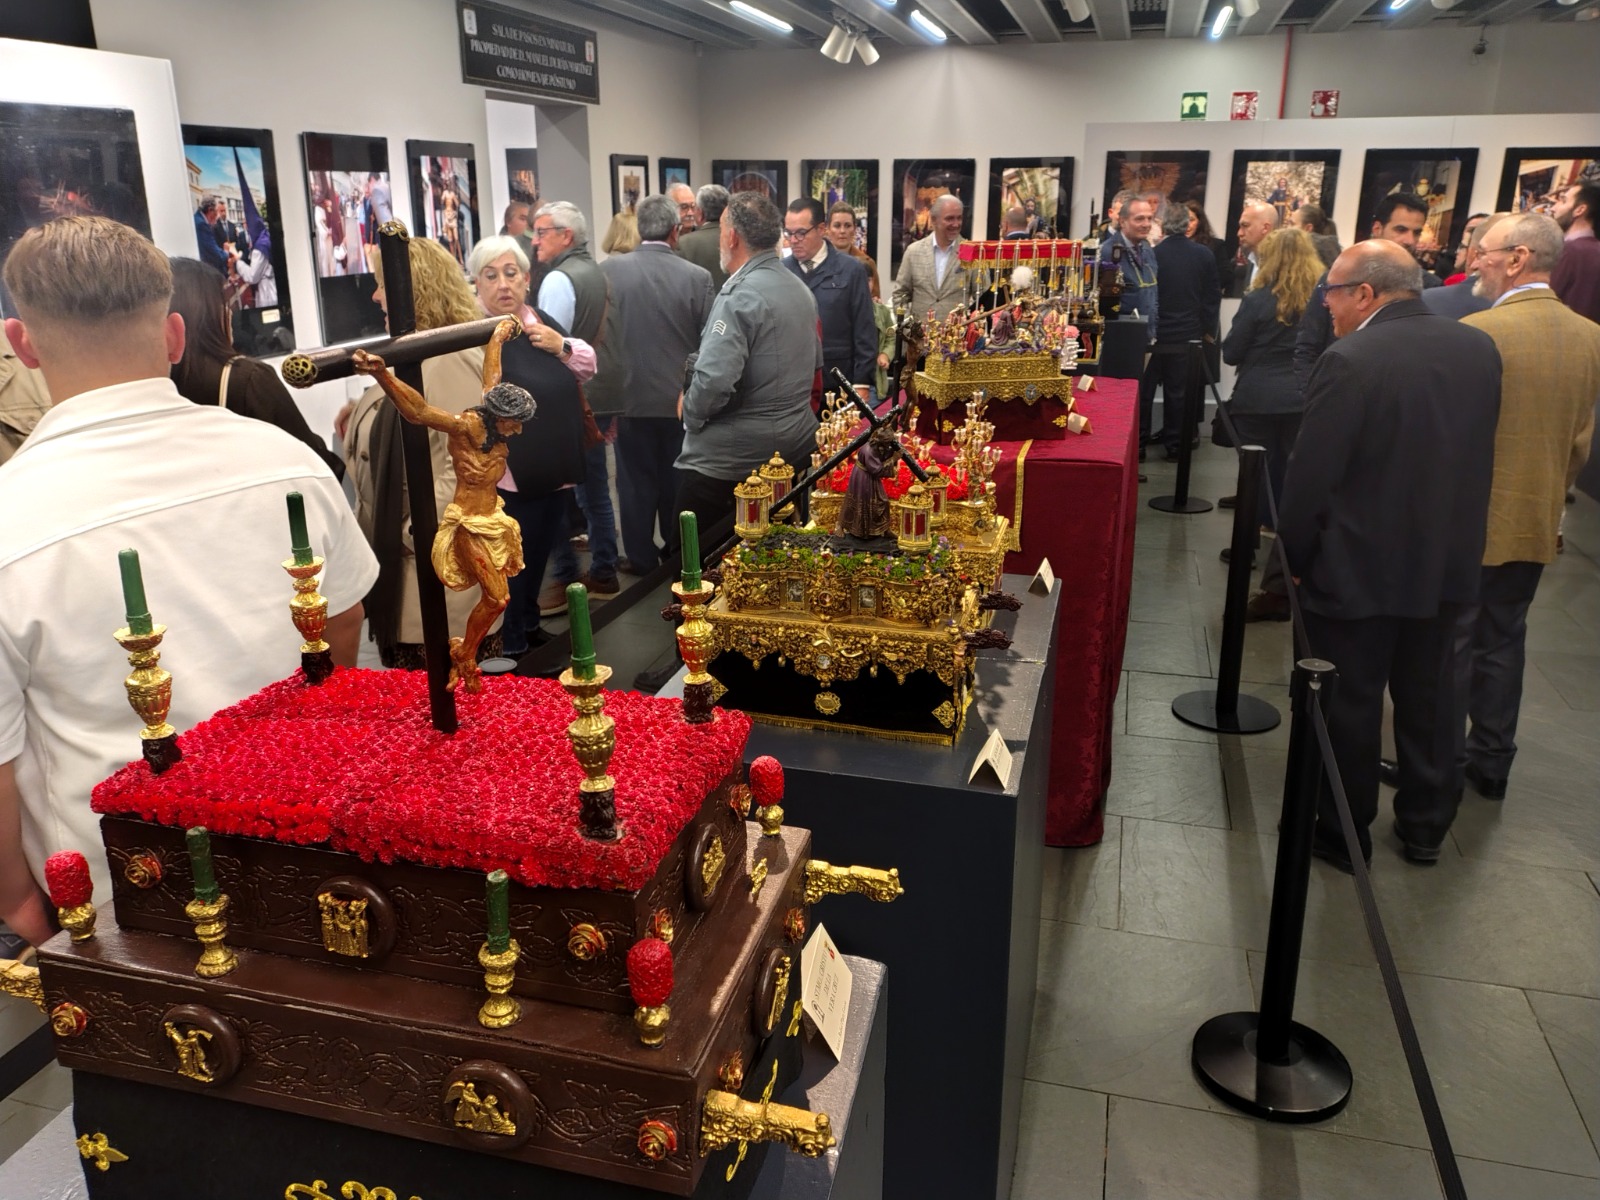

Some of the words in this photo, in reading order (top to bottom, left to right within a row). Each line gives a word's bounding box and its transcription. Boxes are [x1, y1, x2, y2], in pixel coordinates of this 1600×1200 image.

[491, 24, 510, 39] SALA
[470, 38, 509, 59] PROPIEDAD
[525, 50, 549, 68] MANUEL
[496, 64, 518, 81] COMO
[517, 69, 550, 87] HOMENAJE
[549, 73, 576, 91] PÓSTUMO
